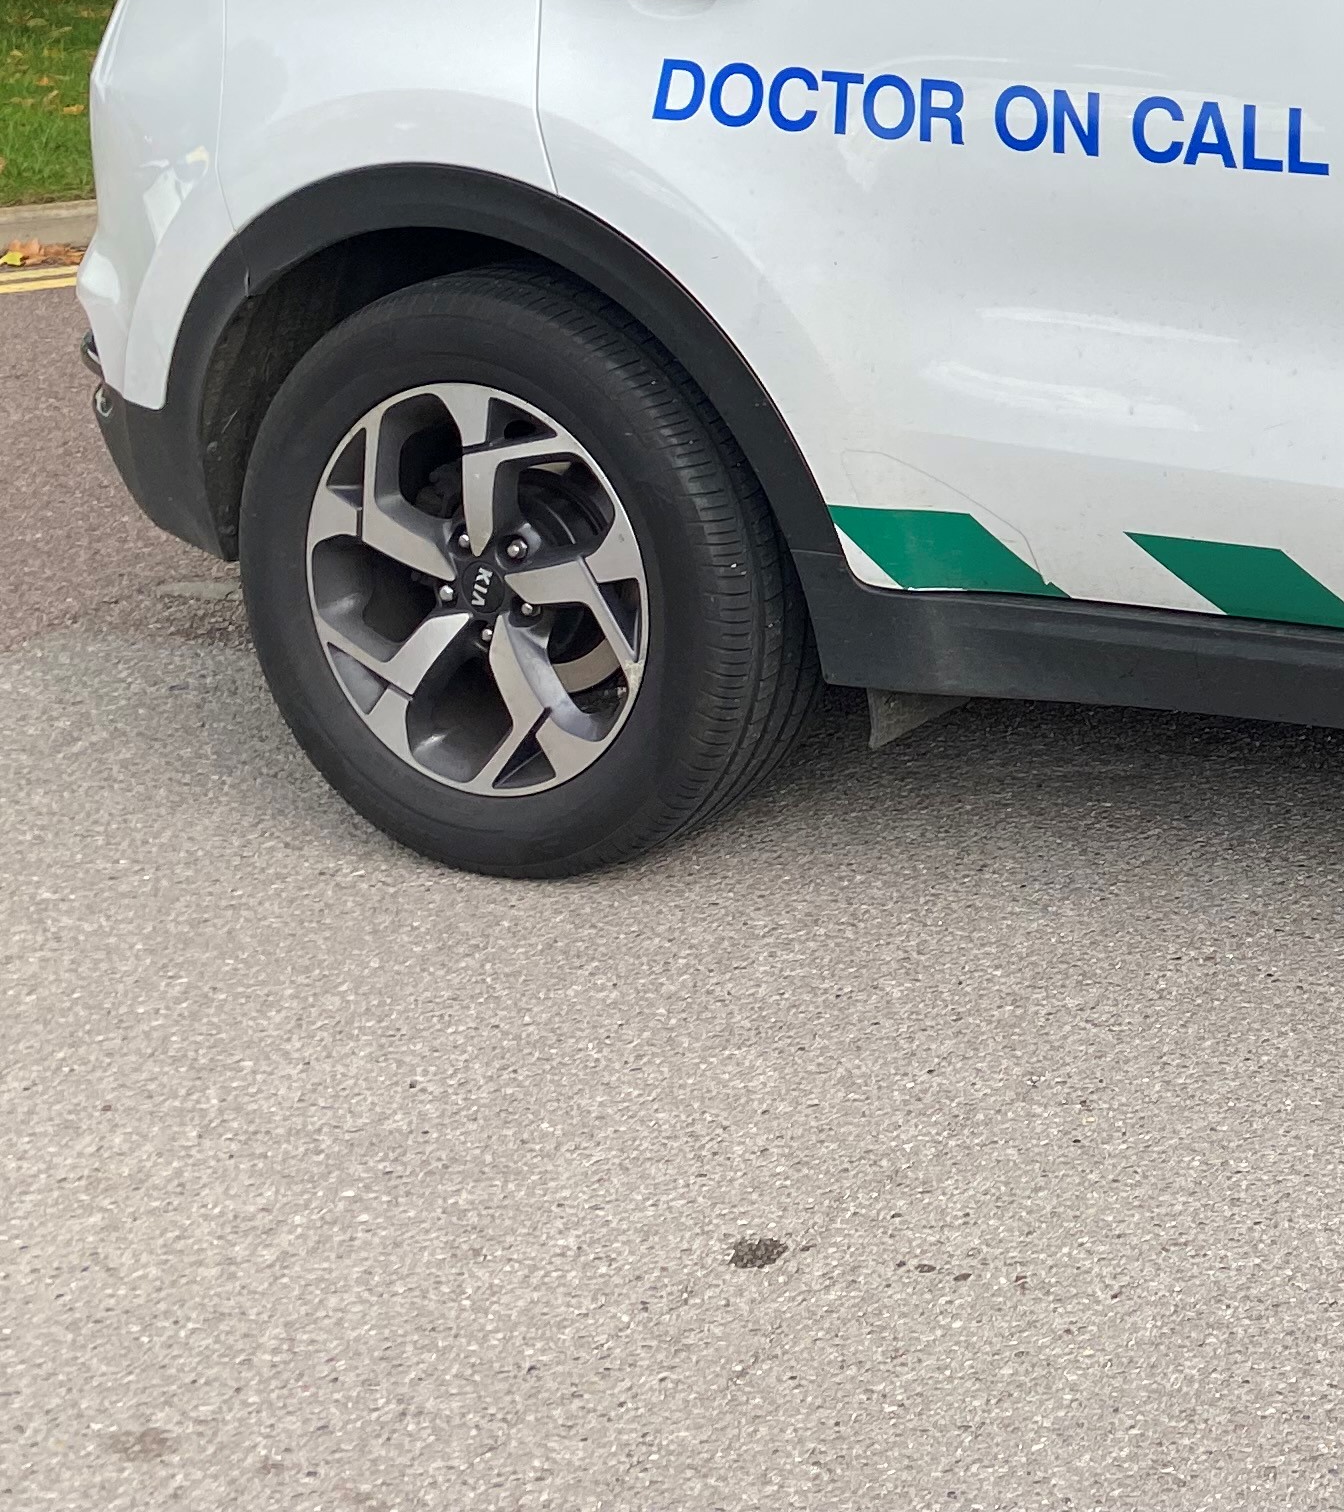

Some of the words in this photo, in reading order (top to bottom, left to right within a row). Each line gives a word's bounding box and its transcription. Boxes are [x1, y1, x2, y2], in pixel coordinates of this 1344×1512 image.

[652, 58, 965, 146] DOCTOR
[994, 85, 1100, 158] ON
[1131, 96, 1330, 176] CALL
[471, 567, 493, 606] KIA
